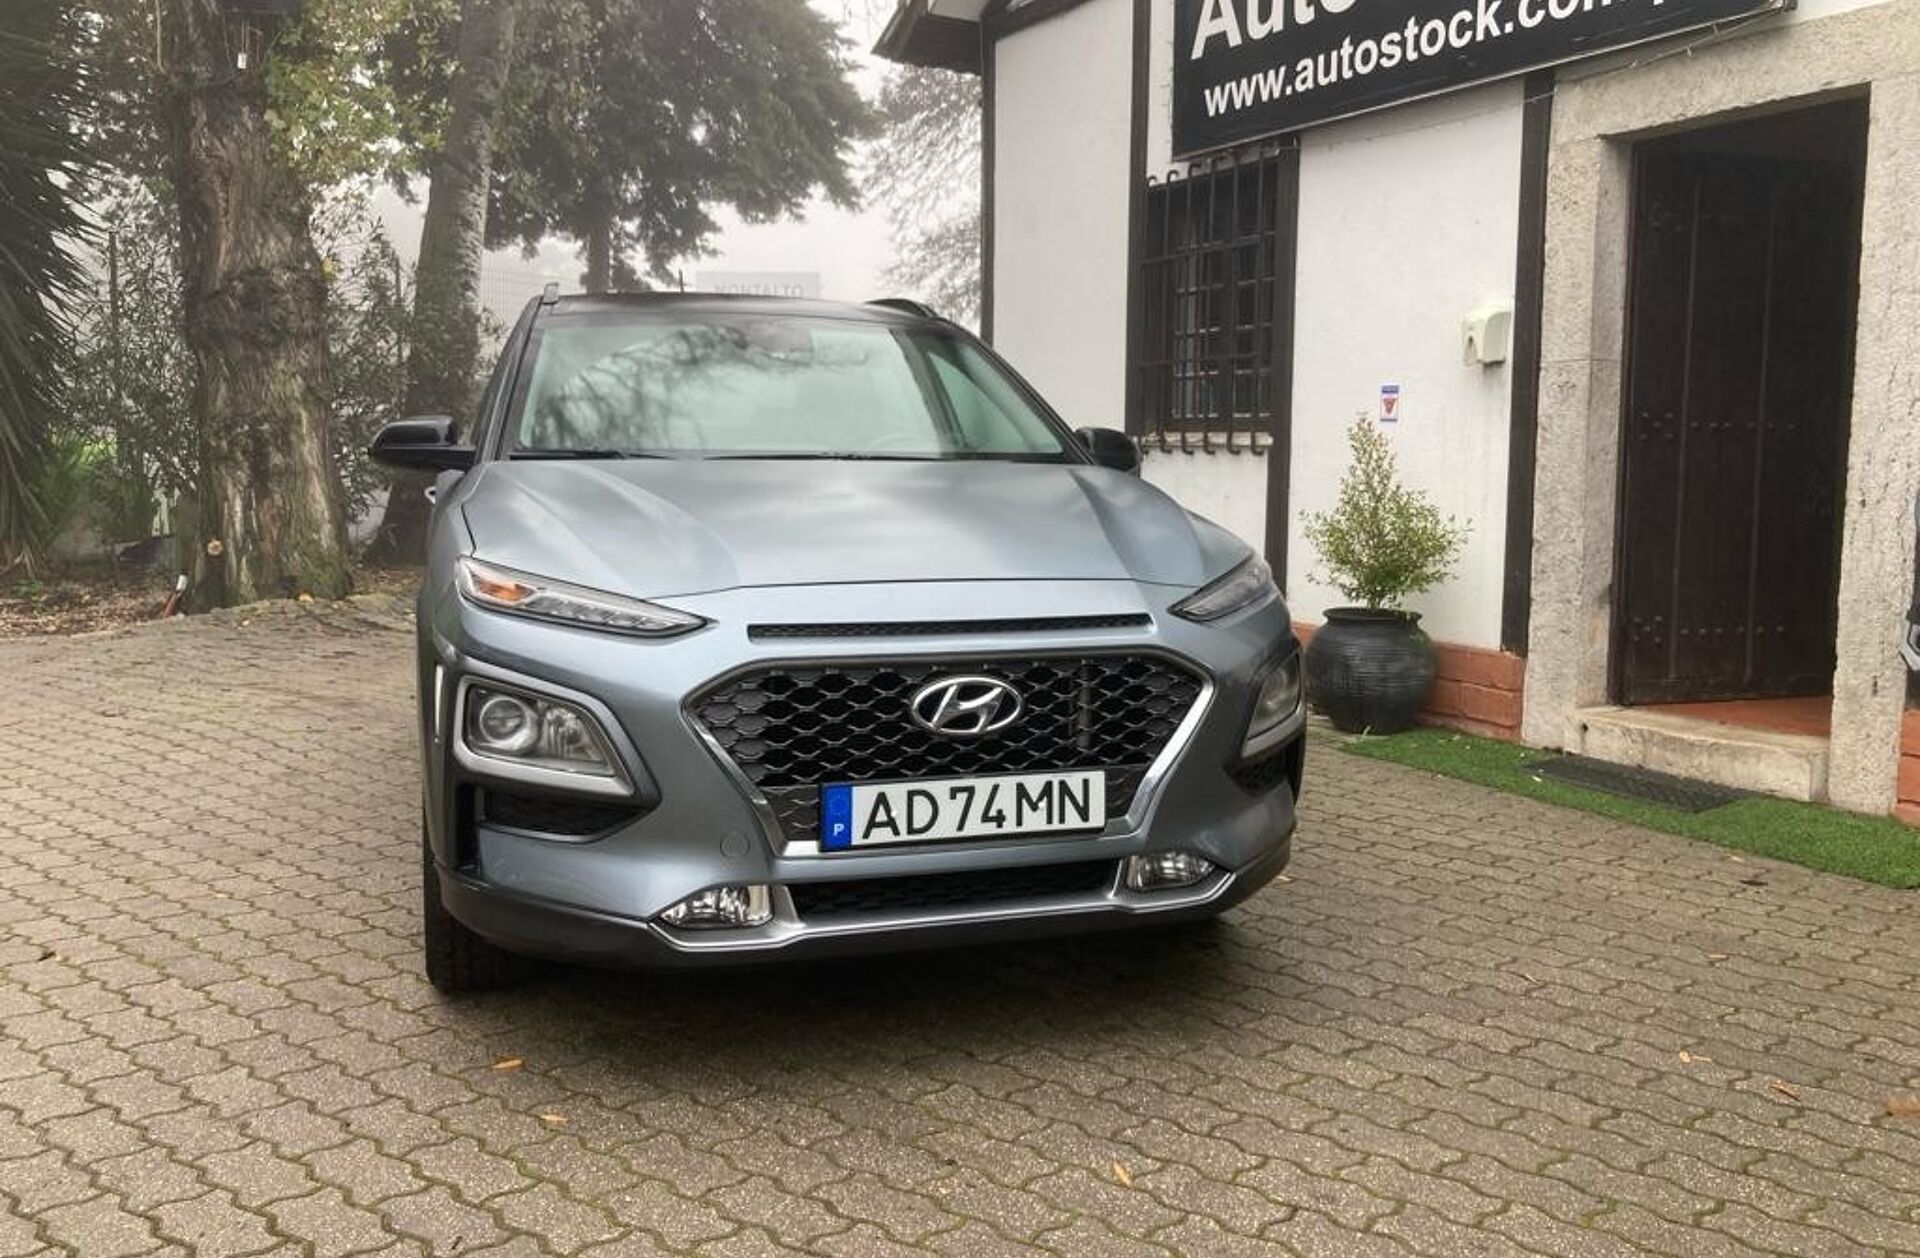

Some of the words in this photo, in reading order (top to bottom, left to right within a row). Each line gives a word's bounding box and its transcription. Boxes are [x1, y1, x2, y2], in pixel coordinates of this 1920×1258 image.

[1191, 0, 1356, 60] Au
[1204, 0, 1612, 117] www.autostock.co
[833, 823, 845, 837] P
